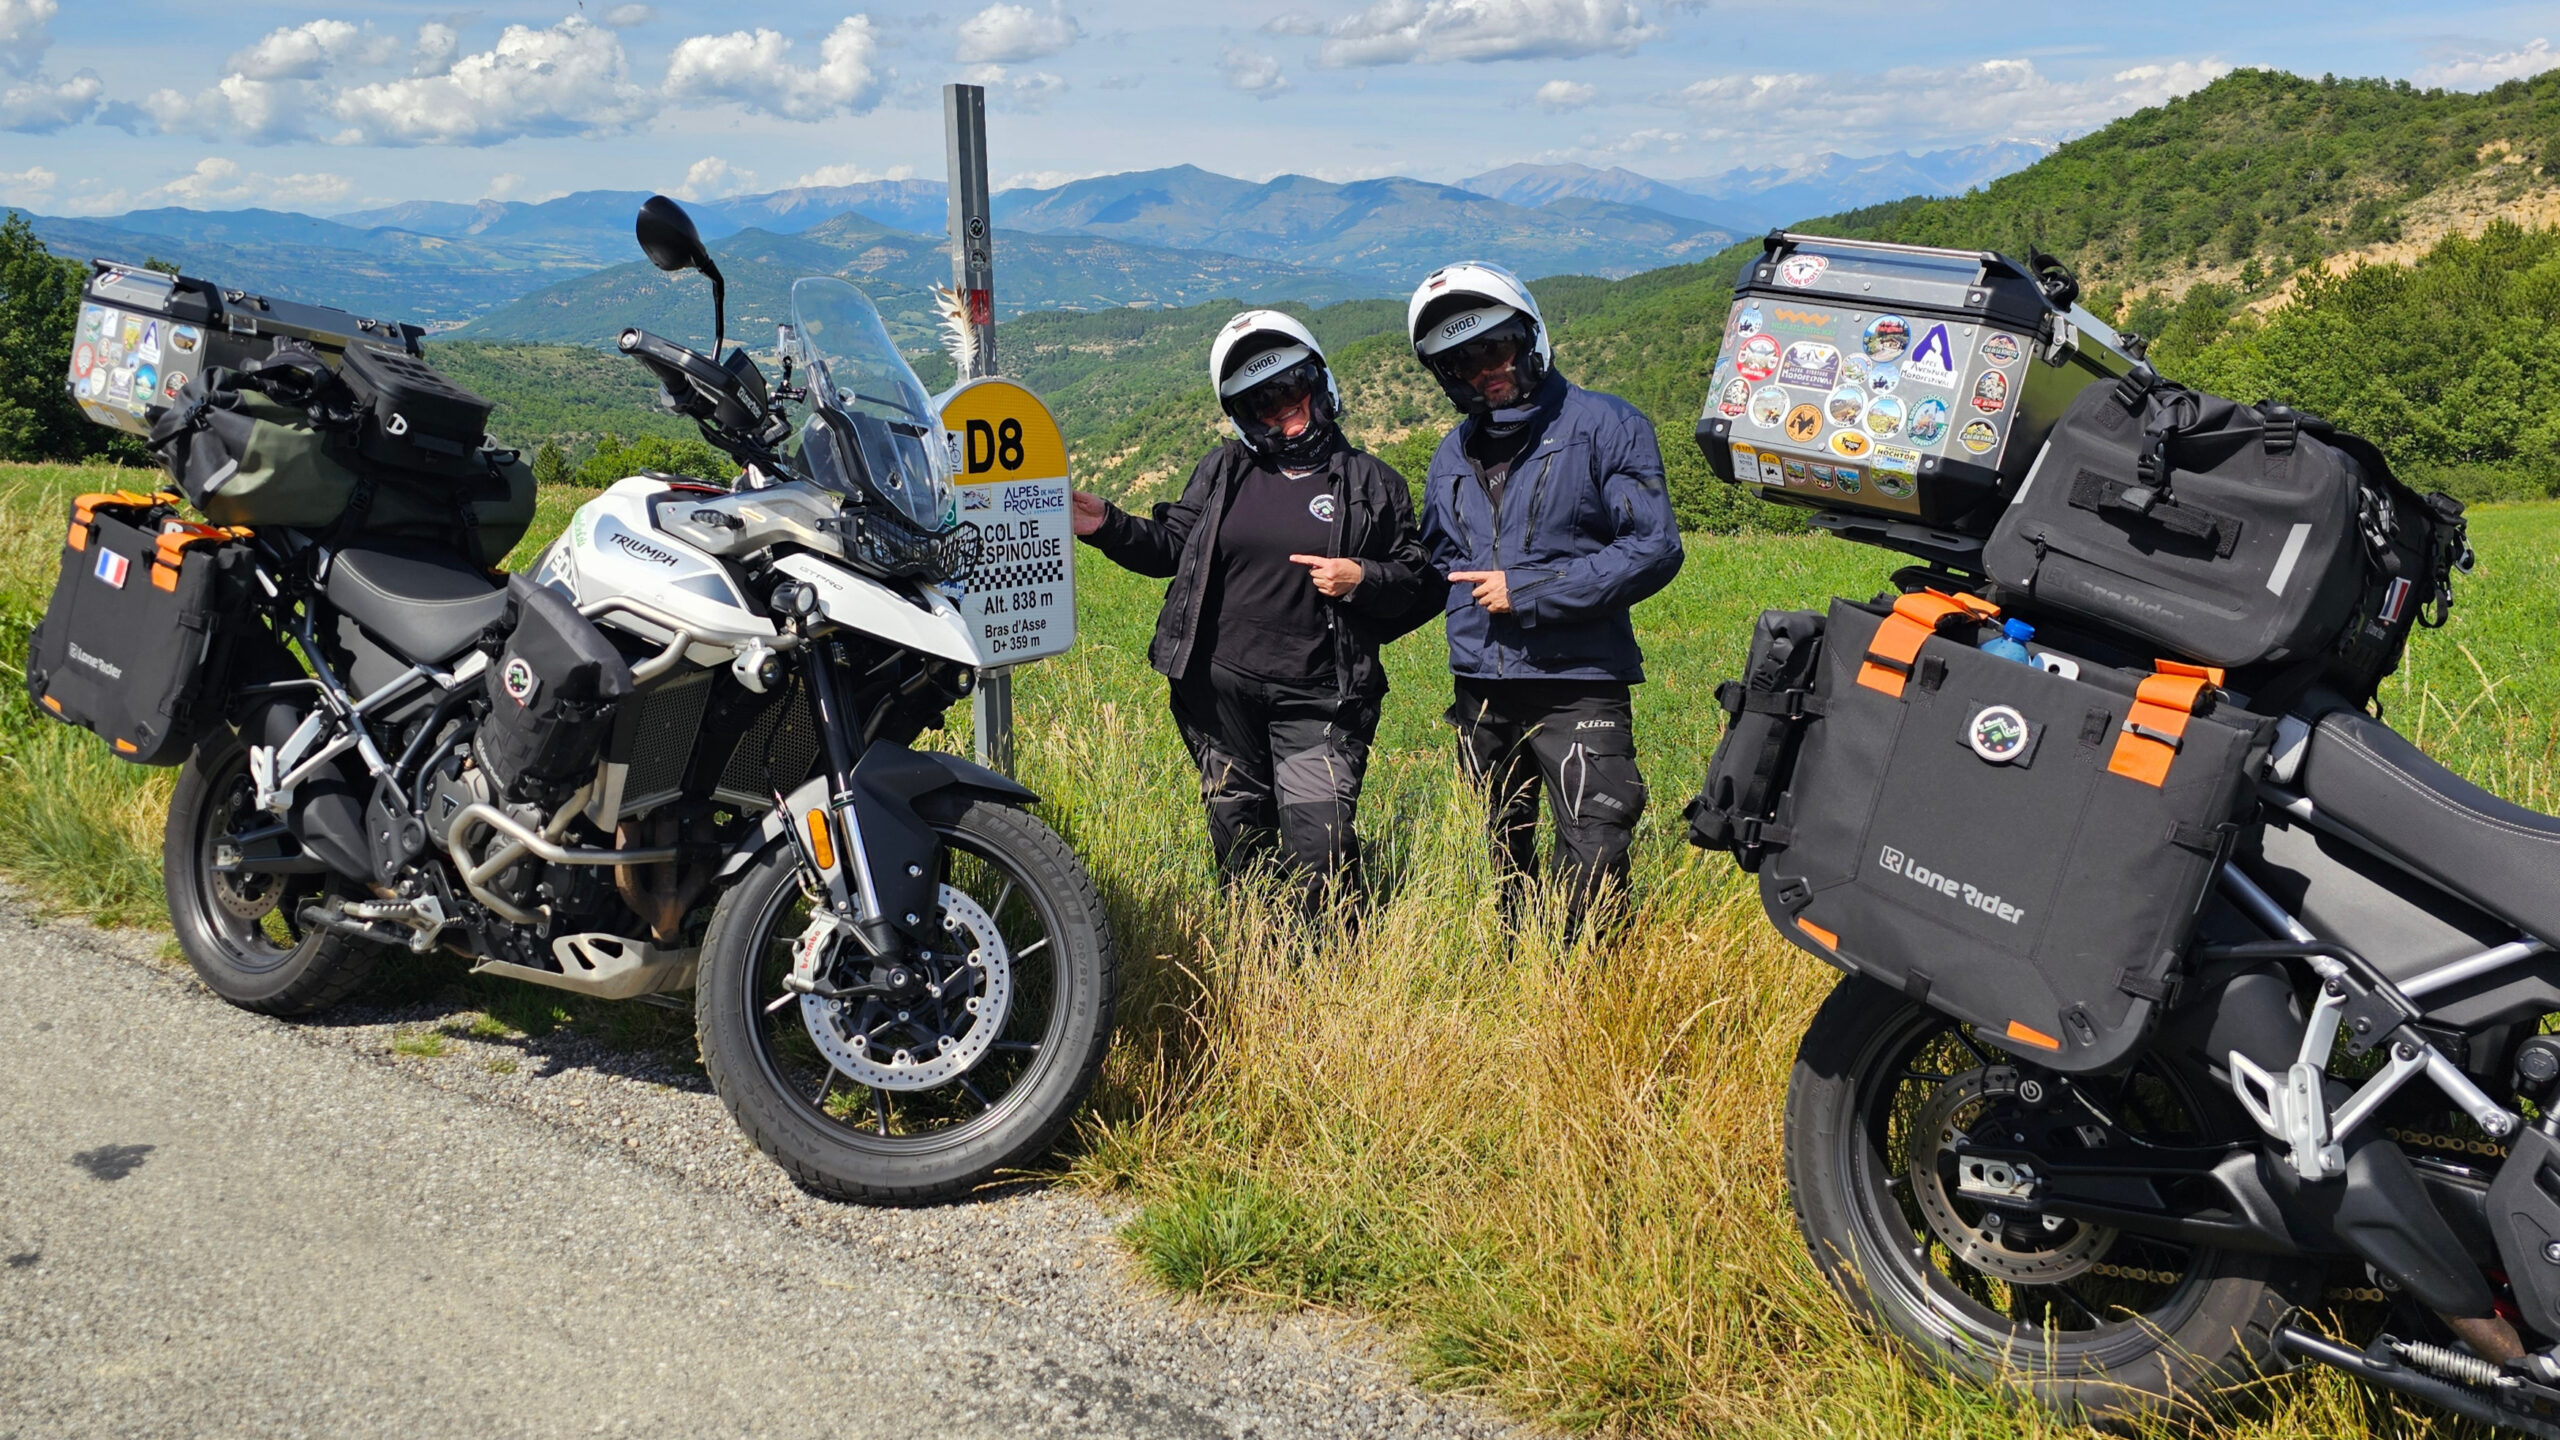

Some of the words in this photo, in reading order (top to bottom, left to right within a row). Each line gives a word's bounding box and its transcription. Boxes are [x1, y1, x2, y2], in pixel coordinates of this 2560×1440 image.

[1446, 316, 1477, 337] SHOEI
[1248, 354, 1277, 375] SHOEI
[966, 417, 1025, 474] D8
[1004, 485, 1040, 500] ALPES
[1004, 496, 1065, 515] PROVENCE
[985, 523, 1015, 543] COL
[1020, 520, 1039, 539] DE
[609, 533, 679, 567] TRIUMPH
[984, 595, 1009, 615] Alt.
[1013, 590, 1037, 611] 838
[1041, 592, 1053, 606] m
[985, 624, 1009, 639] Bras
[1012, 619, 1047, 634] d'Asse
[993, 640, 1007, 653] D+
[1010, 635, 1028, 650] 359
[1031, 636, 1040, 647] m
[985, 816, 1081, 917] MICHELIN
[1905, 858, 1960, 898] Lone
[1962, 883, 2024, 924] Rider
